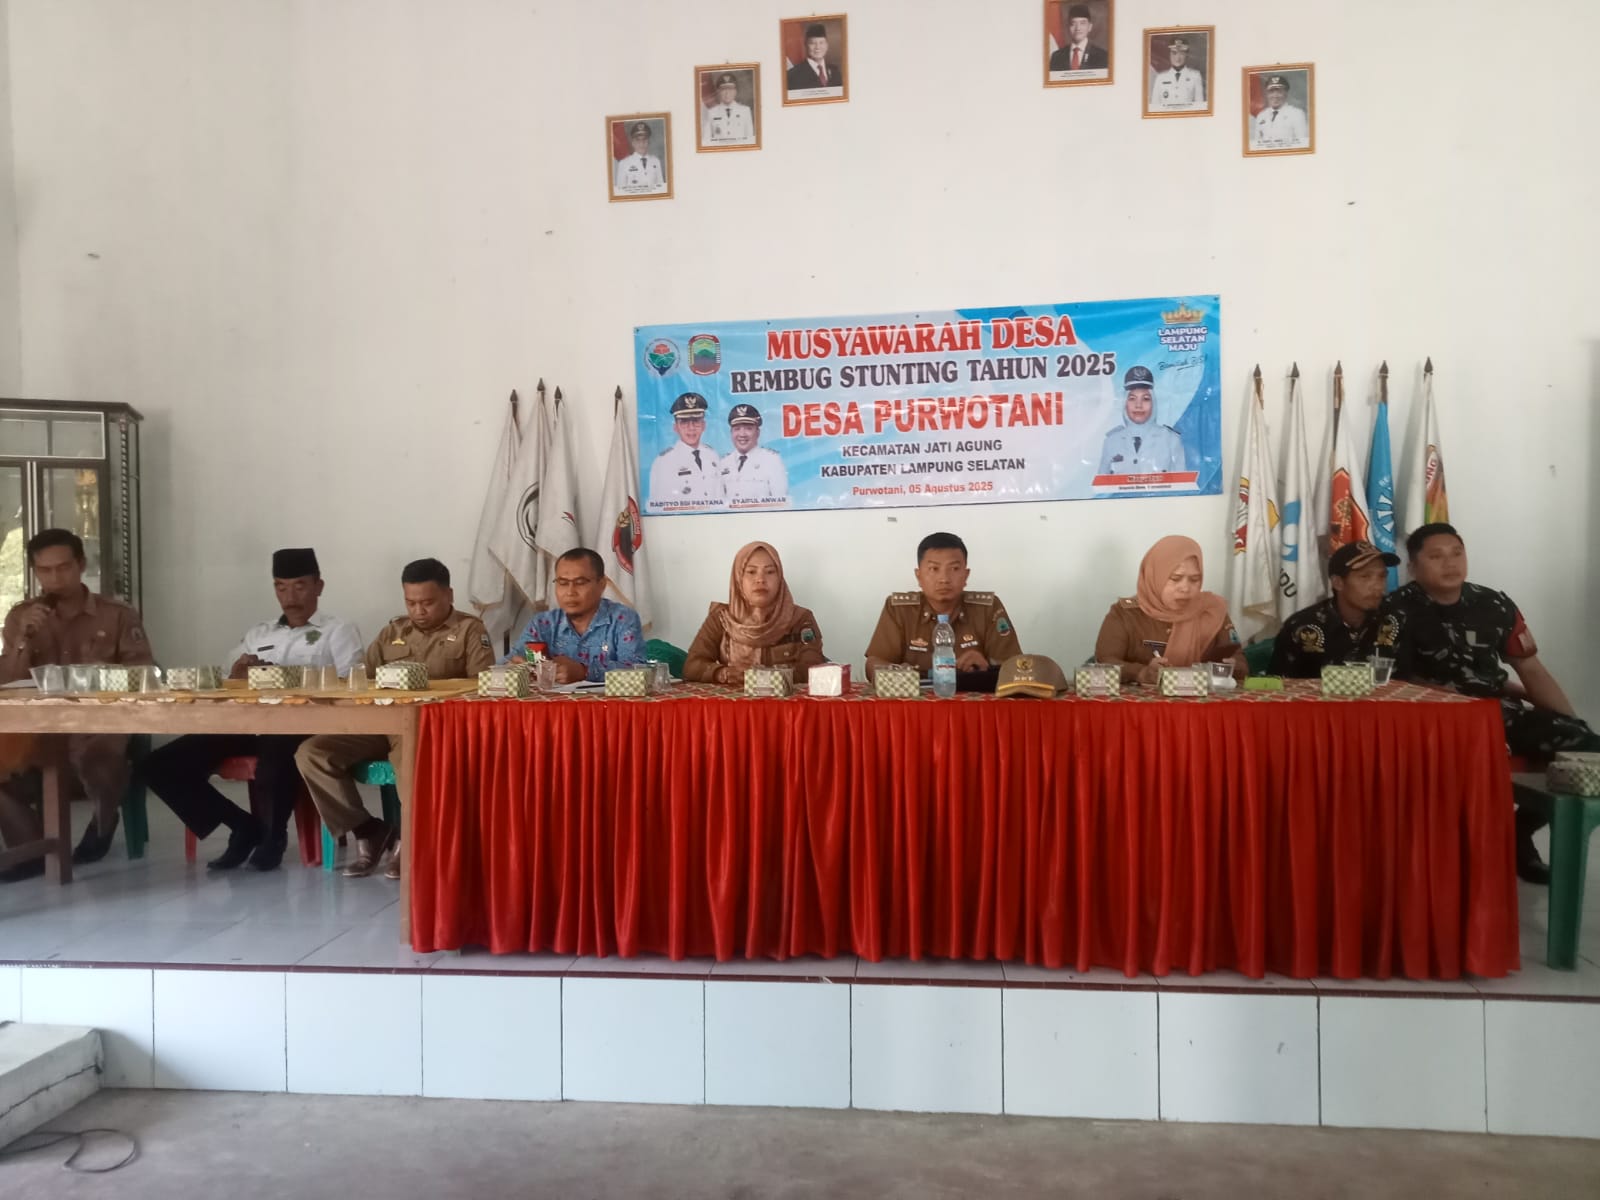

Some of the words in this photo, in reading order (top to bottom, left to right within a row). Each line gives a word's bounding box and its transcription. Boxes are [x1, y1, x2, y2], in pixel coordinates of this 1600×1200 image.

[767, 321, 982, 361] MUSYAWARAH
[992, 315, 1077, 350] DESA
[1158, 327, 1207, 336] LAMPUNG
[1160, 335, 1206, 344] SELATAN
[1168, 343, 1197, 351] MAJU
[731, 366, 832, 393] REMBUG
[840, 360, 958, 388] STUNTING
[967, 356, 1048, 383] TAHUN
[1056, 352, 1116, 378] 2025
[782, 401, 865, 438] DESA
[874, 392, 1064, 433] PURWOTANI
[842, 443, 920, 457] KECAMATAN
[924, 441, 951, 454] JATI
[955, 439, 1003, 453] AGUNG
[821, 463, 897, 477] KABUPATEN
[901, 461, 963, 475] LAMPUNG
[967, 458, 1025, 471] SELATAN
[852, 485, 906, 497] Purwotani,
[909, 484, 922, 494] 05
[924, 483, 965, 495] Agustus
[968, 482, 993, 492] 2025
